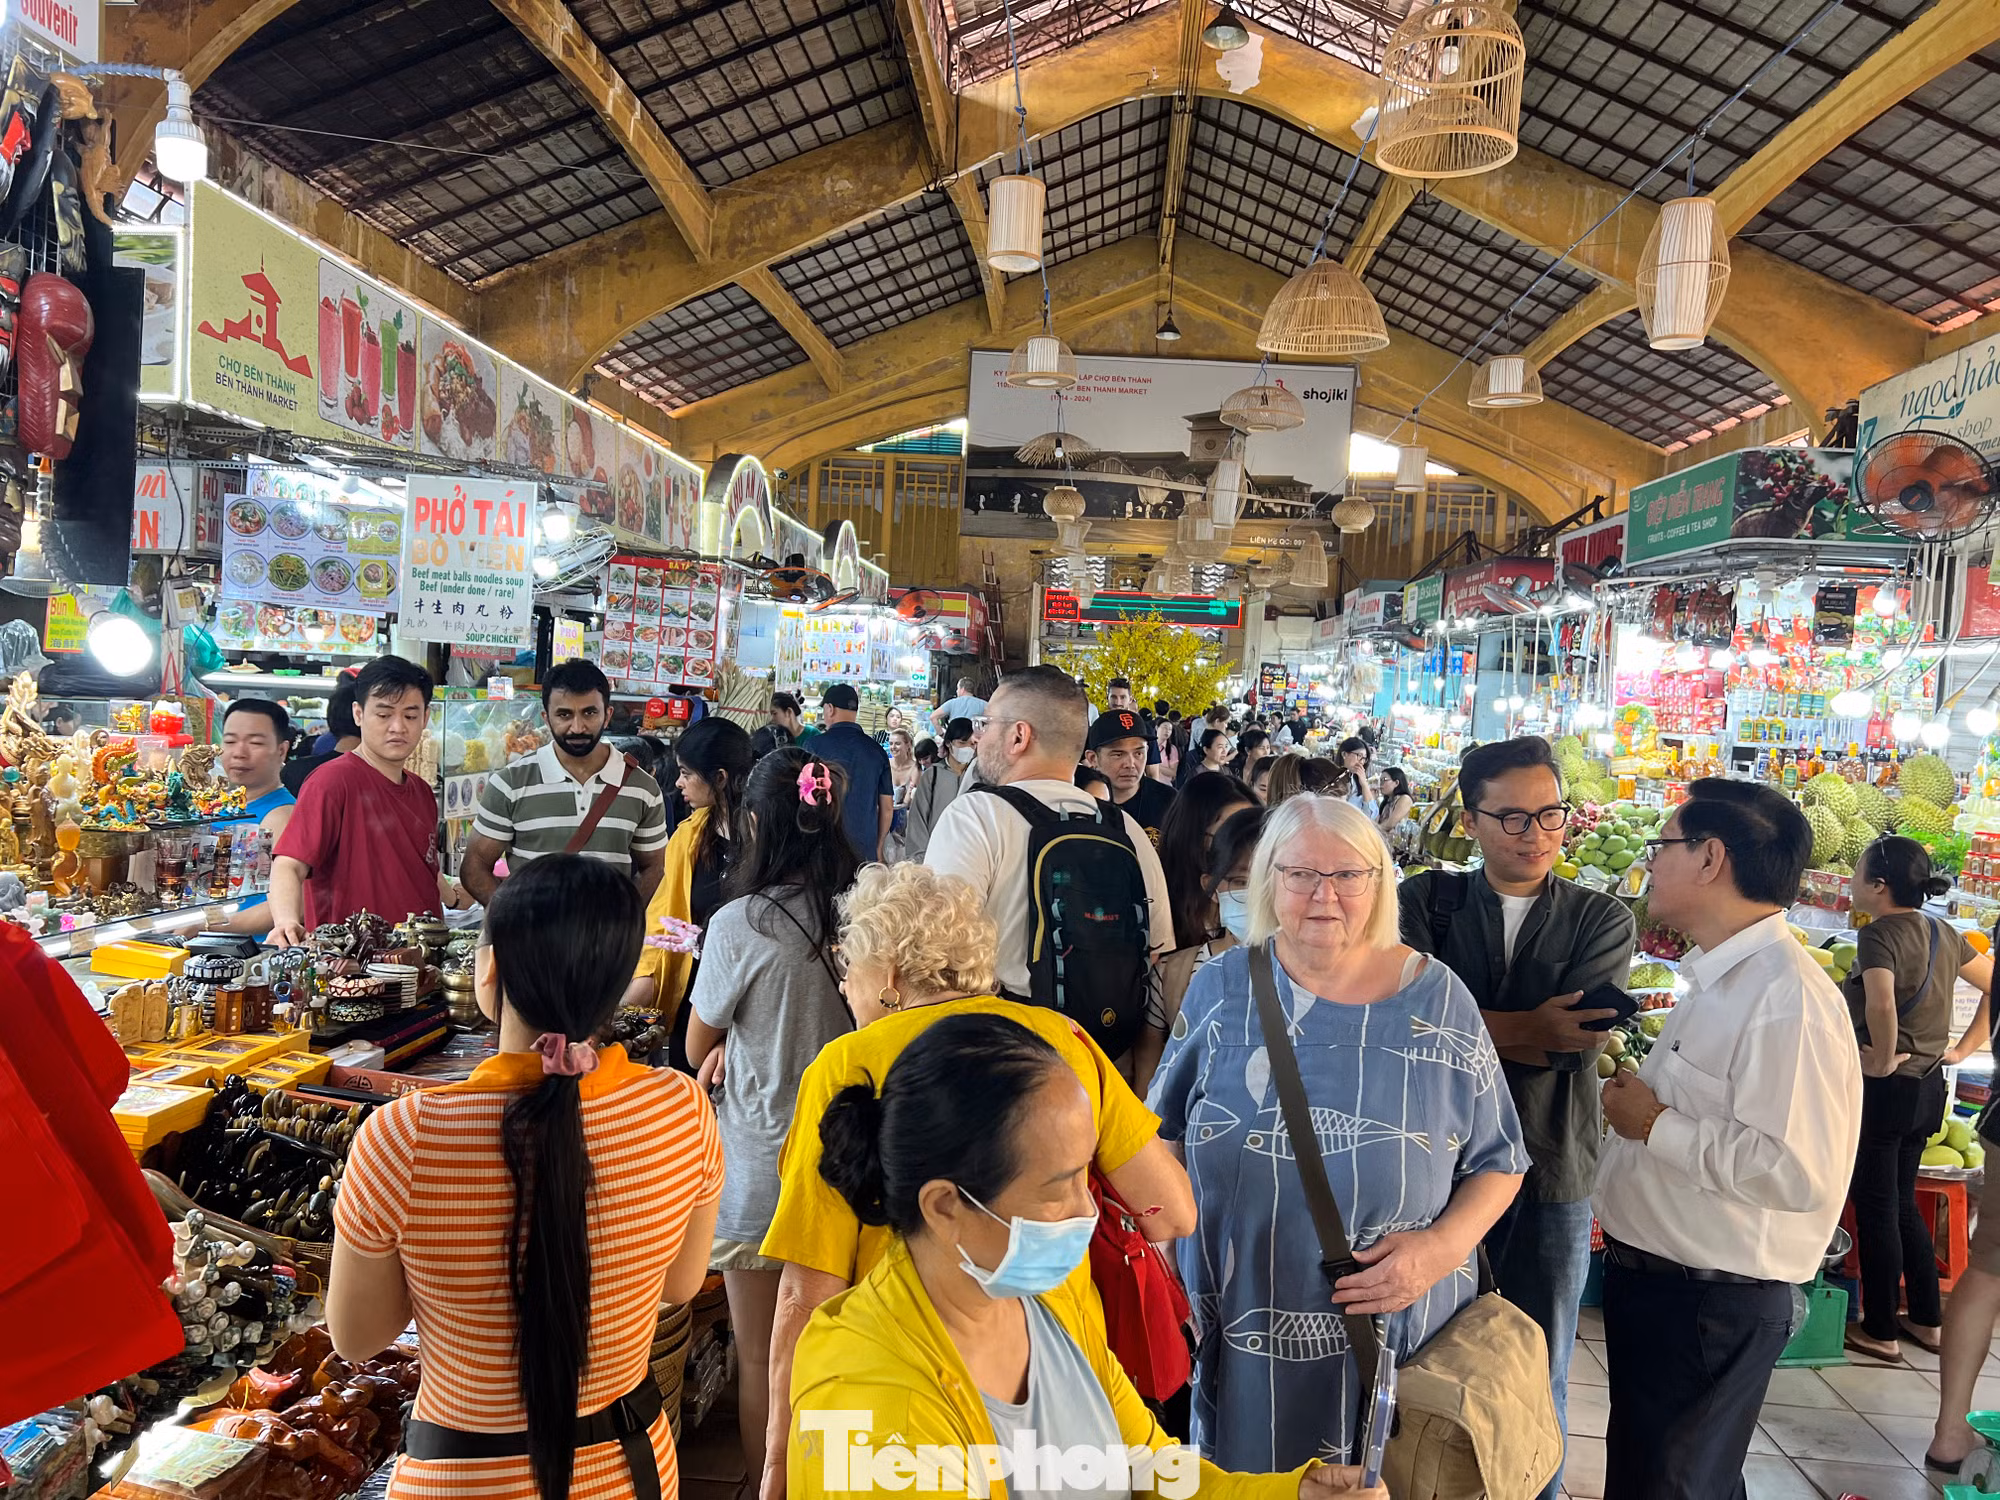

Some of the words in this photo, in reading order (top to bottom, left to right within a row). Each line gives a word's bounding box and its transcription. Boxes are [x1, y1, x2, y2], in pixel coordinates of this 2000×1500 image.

[218, 355, 241, 378] CHỢ
[244, 360, 263, 382] BẾN
[265, 371, 296, 396] THÀNH
[1094, 374, 1110, 383] CHỢ
[1111, 374, 1126, 383] BẾN
[1127, 375, 1152, 384] THÀNH
[215, 371, 234, 388] BẾN
[236, 378, 264, 399] THÀNH
[266, 392, 298, 412] MARKET
[1074, 395, 1092, 403] 2024)
[1077, 385, 1092, 393] BEN
[1093, 386, 1118, 394] THANH
[1119, 387, 1147, 395] MARKET
[1303, 388, 1348, 403] shojiki
[1957, 417, 1992, 439] shop
[414, 484, 467, 536] PHỞ
[473, 490, 526, 538] TÁI
[1647, 532, 1664, 544] FRUITS
[1666, 525, 1686, 539] COFFEE
[1691, 521, 1701, 531] TEA
[1702, 516, 1718, 530] SHOP
[411, 533, 448, 566] BÒ
[411, 567, 430, 579] Beef
[431, 570, 450, 581] meat
[453, 571, 472, 583] balls
[473, 573, 503, 585] noodles
[505, 577, 524, 588] soup
[419, 580, 438, 592] Beef
[440, 582, 465, 594] (under
[467, 584, 486, 596] done
[487, 586, 492, 596] /
[494, 588, 515, 599] rare)
[465, 633, 485, 643] SOUP
[485, 634, 519, 644] CHICKEN
[1119, 713, 1134, 730] SF
